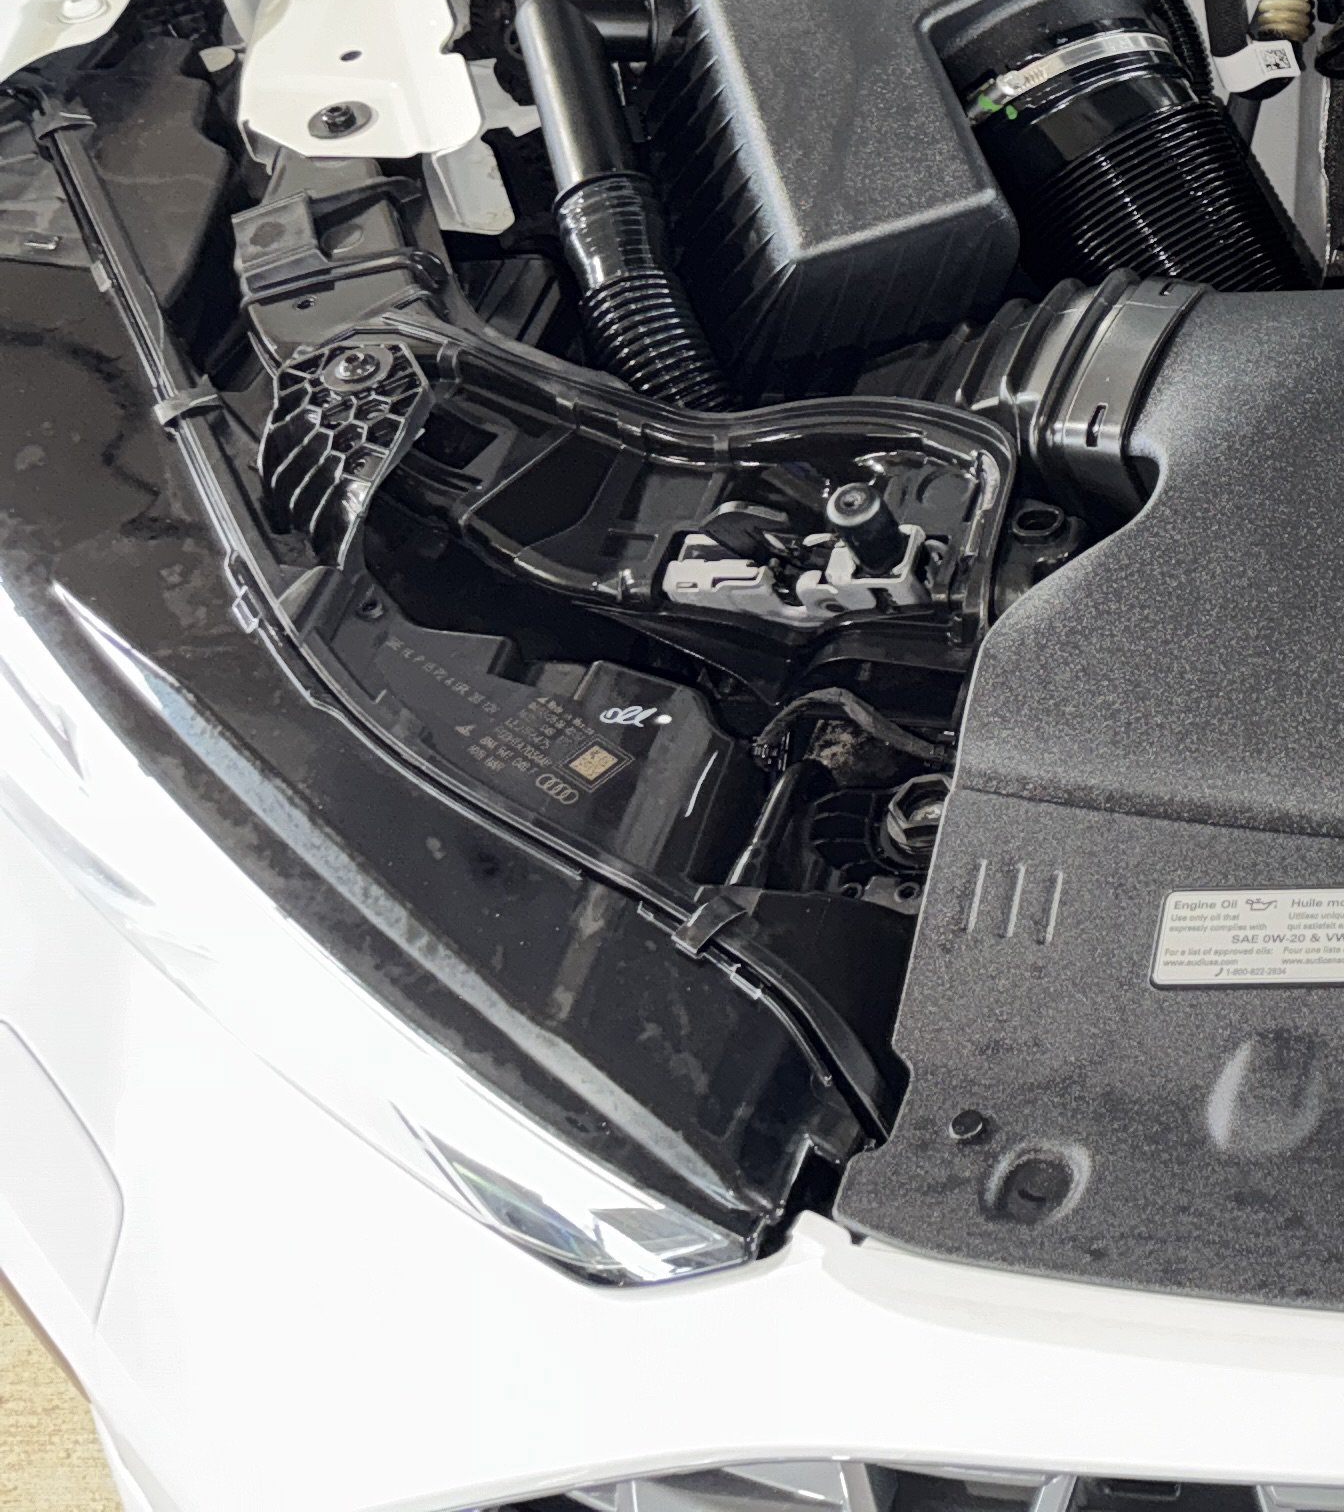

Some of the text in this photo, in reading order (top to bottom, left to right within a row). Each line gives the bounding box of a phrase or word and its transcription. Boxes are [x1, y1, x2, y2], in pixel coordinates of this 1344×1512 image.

[1174, 900, 1238, 912] Engine Oil
[1291, 898, 1323, 908] Huile
[1232, 934, 1258, 943] SAE
[1263, 934, 1306, 943] 0W-20
